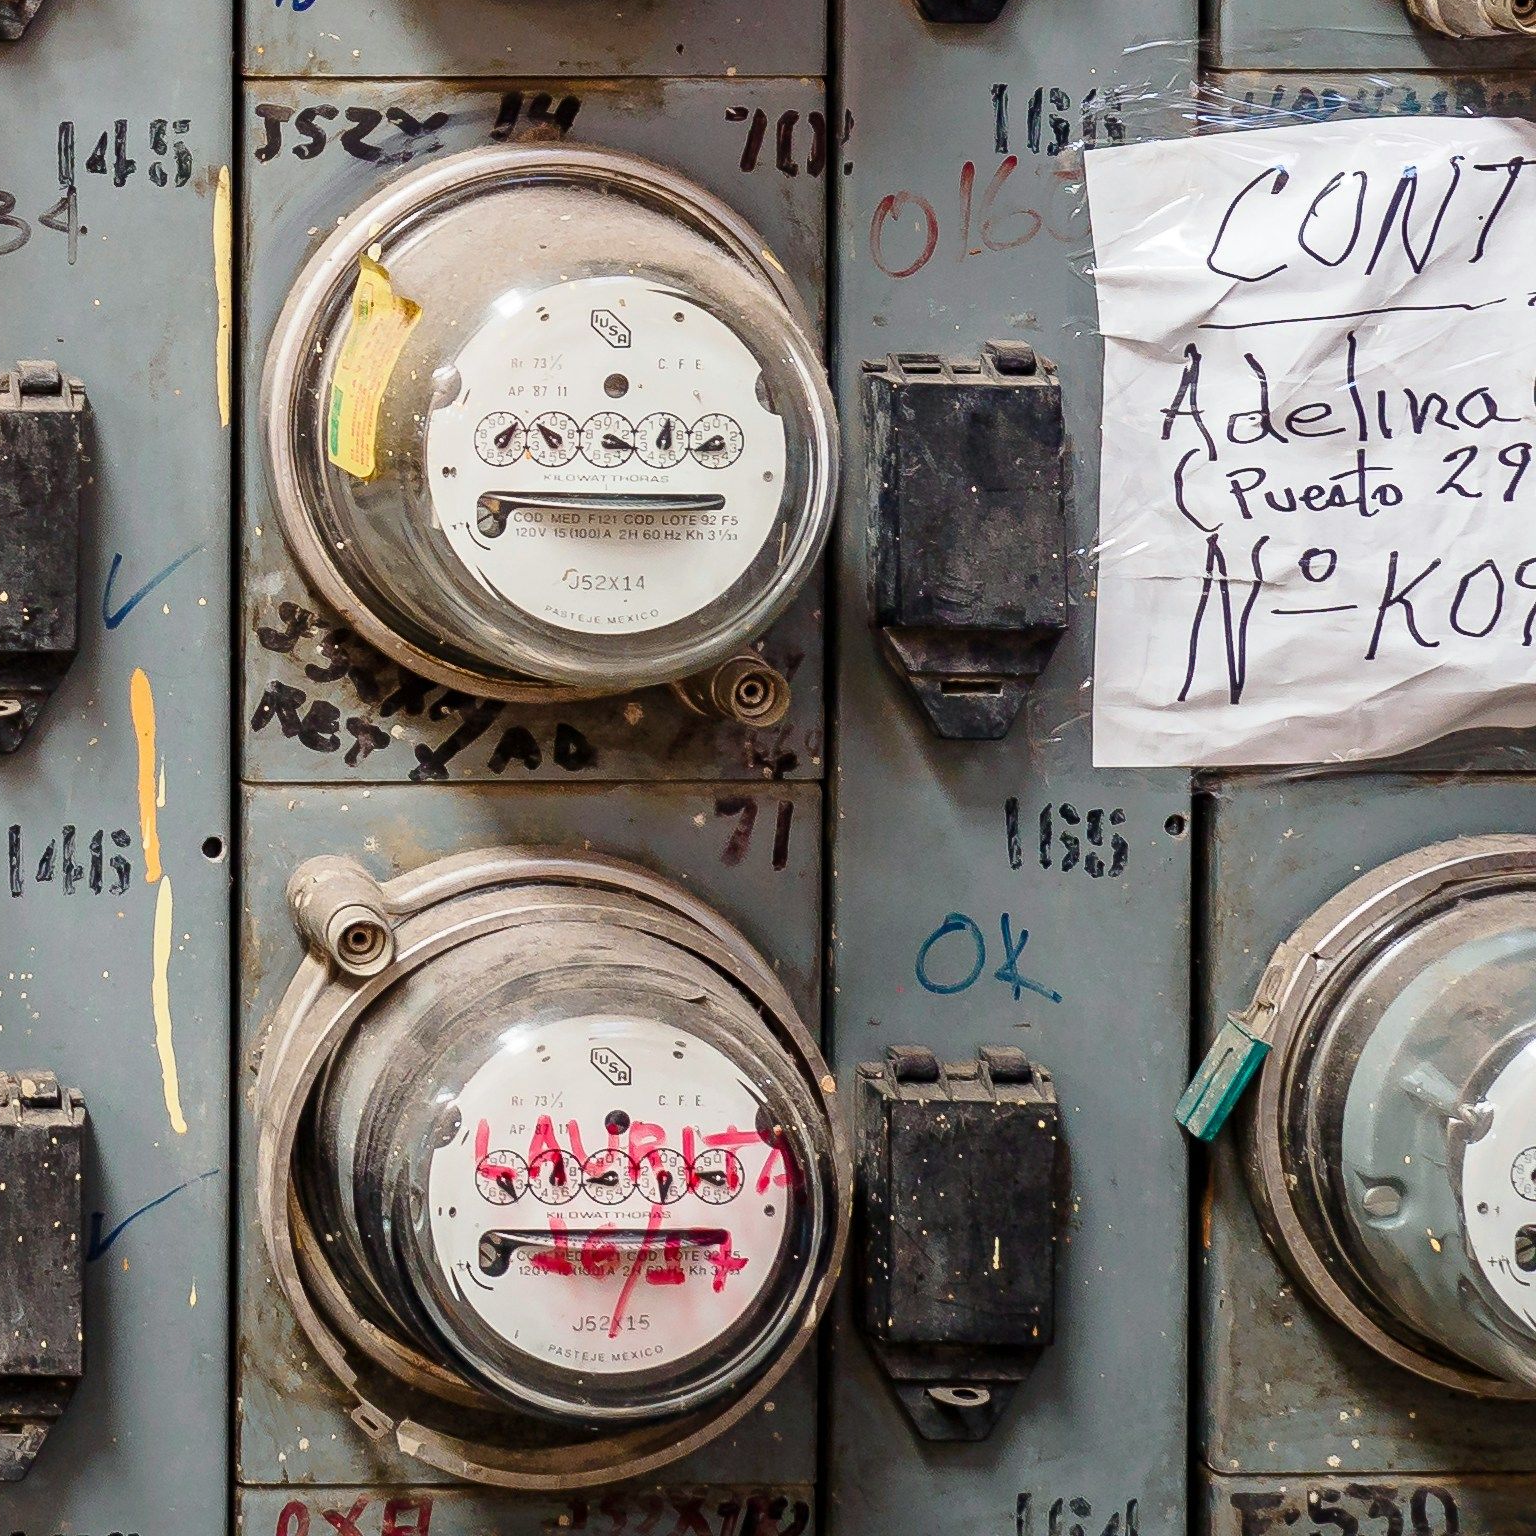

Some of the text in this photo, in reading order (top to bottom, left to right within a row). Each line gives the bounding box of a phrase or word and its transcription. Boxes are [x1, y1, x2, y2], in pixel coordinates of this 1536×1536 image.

[58, 119, 192, 188] 145
[594, 312, 629, 345] IUSA
[1161, 331, 1521, 462] Adelina
[661, 515, 697, 526] LOTE
[8, 824, 131, 898] 146
[715, 797, 794, 871] 71
[1006, 797, 1128, 877] 165
[914, 912, 1062, 1003] OK
[593, 1050, 630, 1084] IUSA
[611, 1344, 664, 1362] MEXICO
